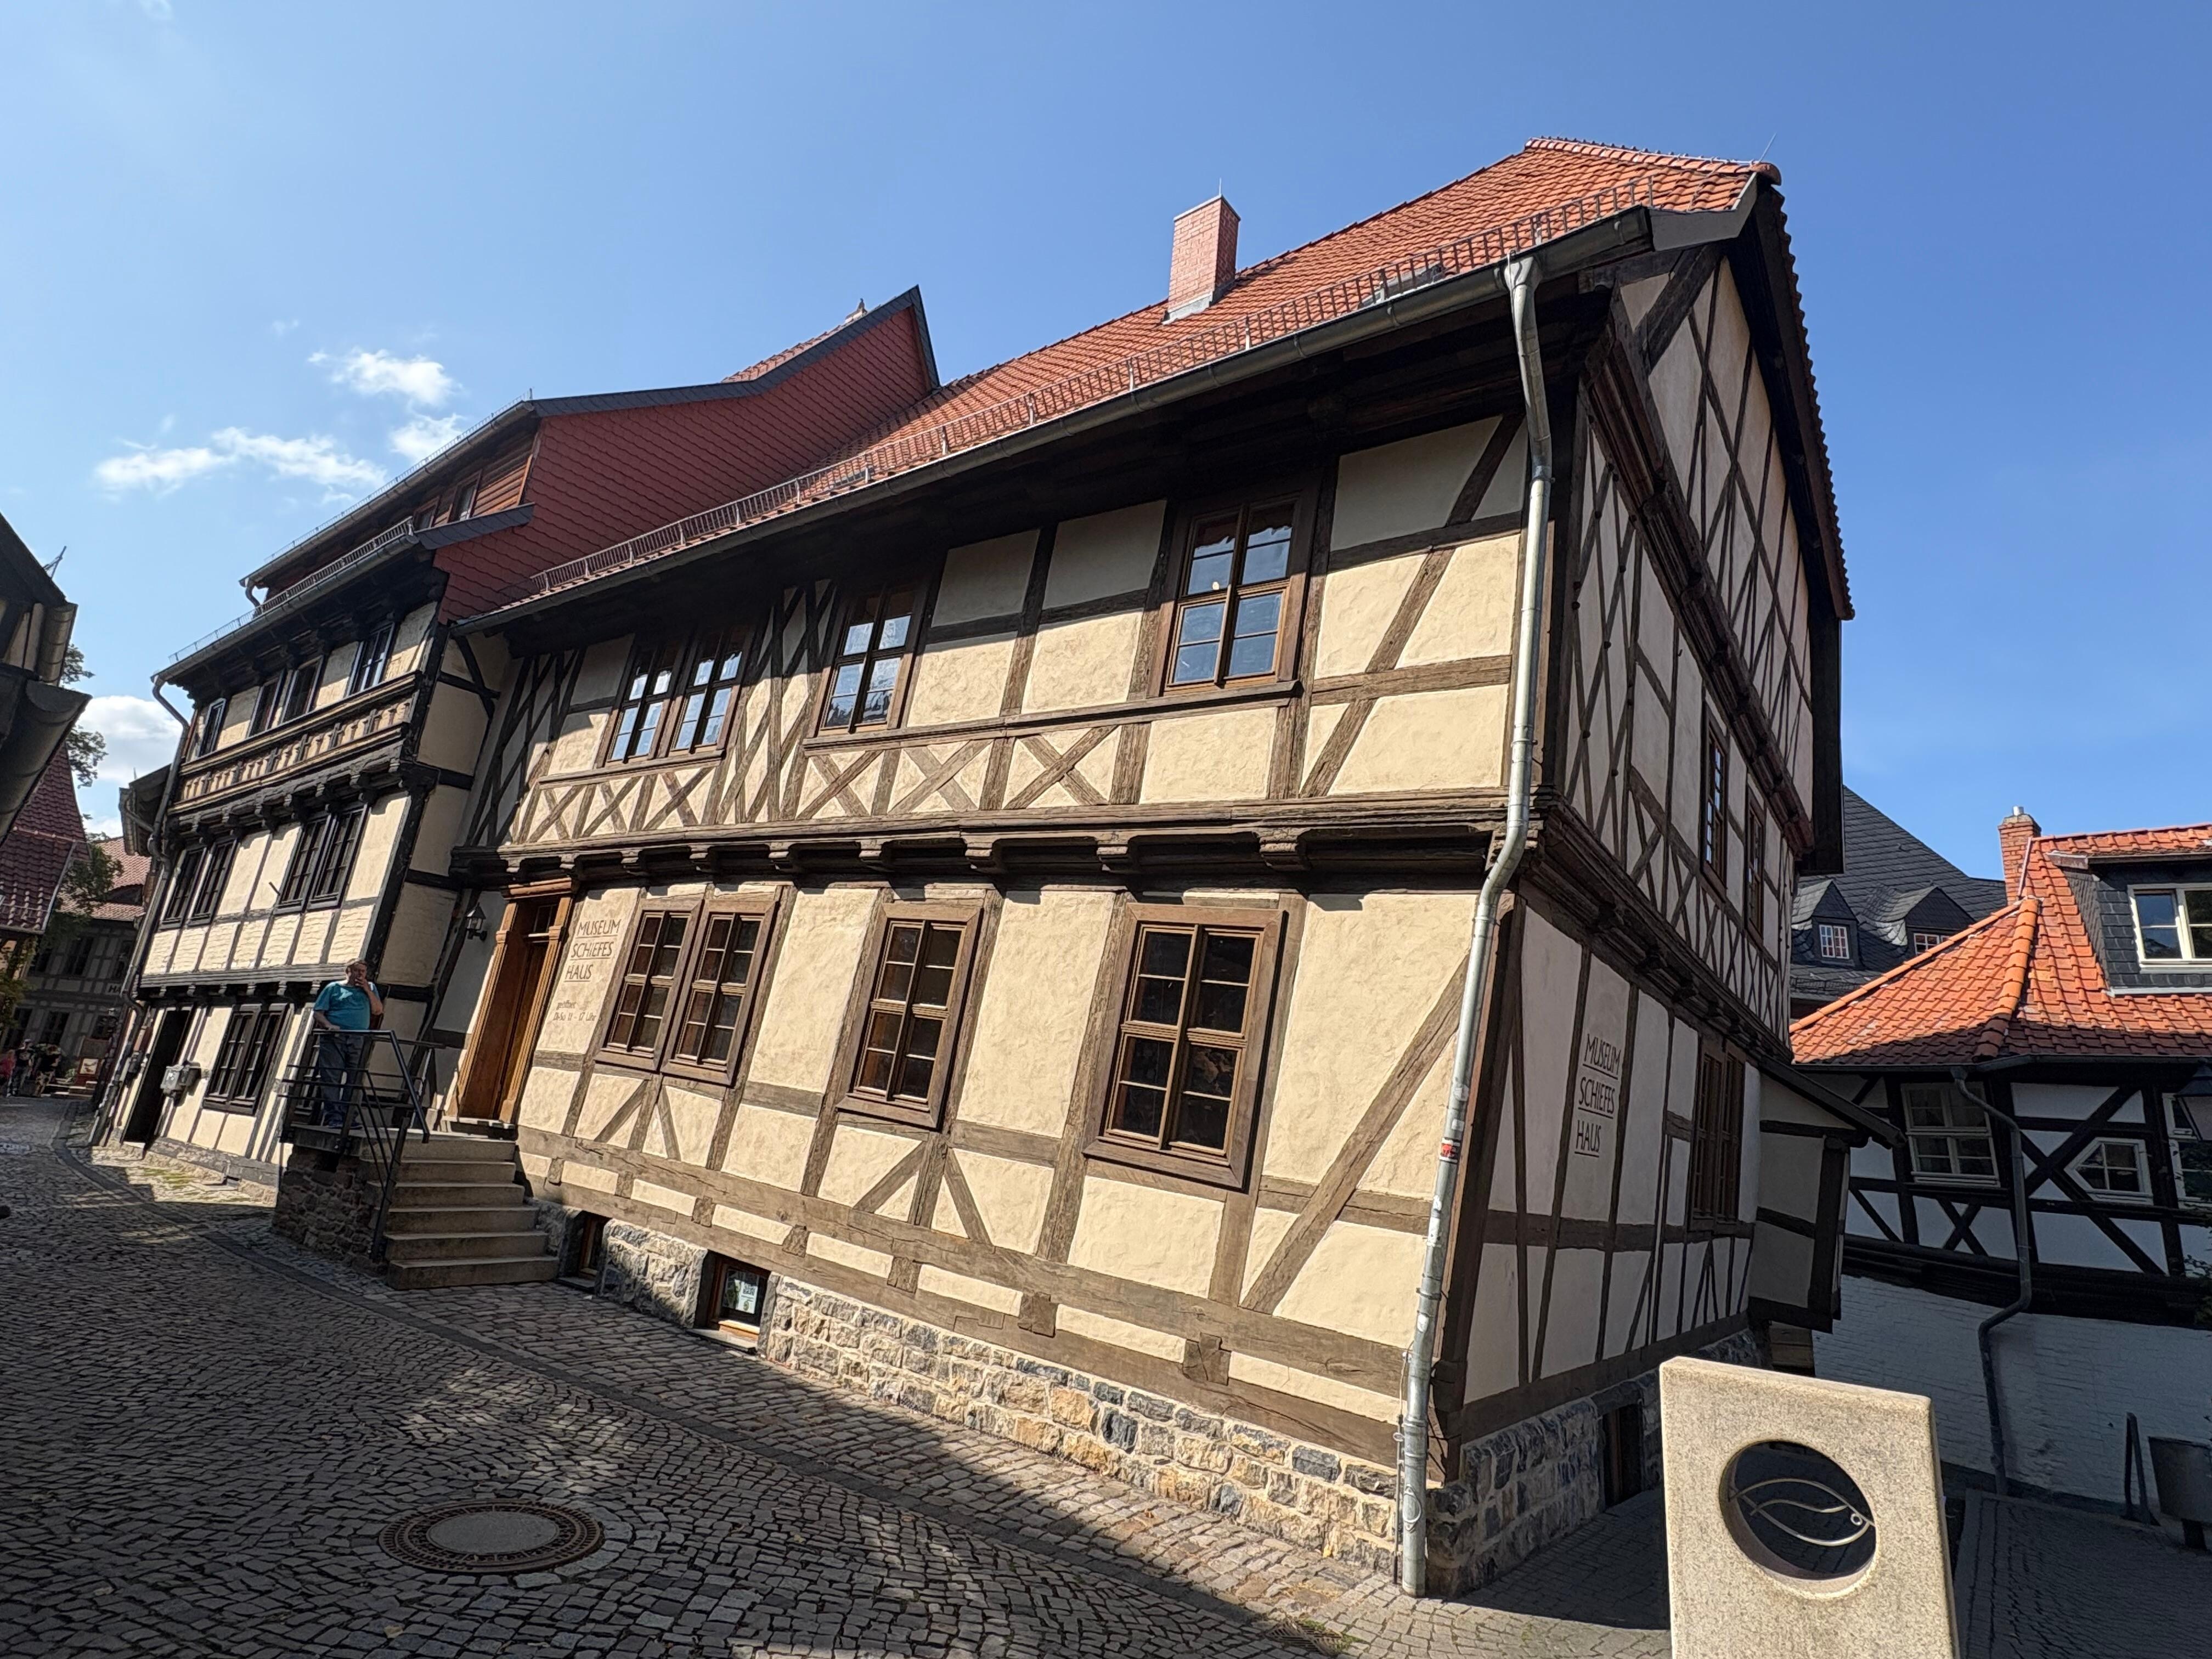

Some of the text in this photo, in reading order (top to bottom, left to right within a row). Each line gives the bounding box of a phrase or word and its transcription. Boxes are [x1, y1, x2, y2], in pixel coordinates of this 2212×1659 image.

[577, 918, 622, 936] MUSEUM
[571, 941, 614, 958] SCHIEFES
[565, 964, 594, 980] HAUS
[1584, 1034, 1622, 1075] MUSEUM
[1578, 1076, 1616, 1114] SCHIEFES
[1575, 1120, 1601, 1153] HAUS
